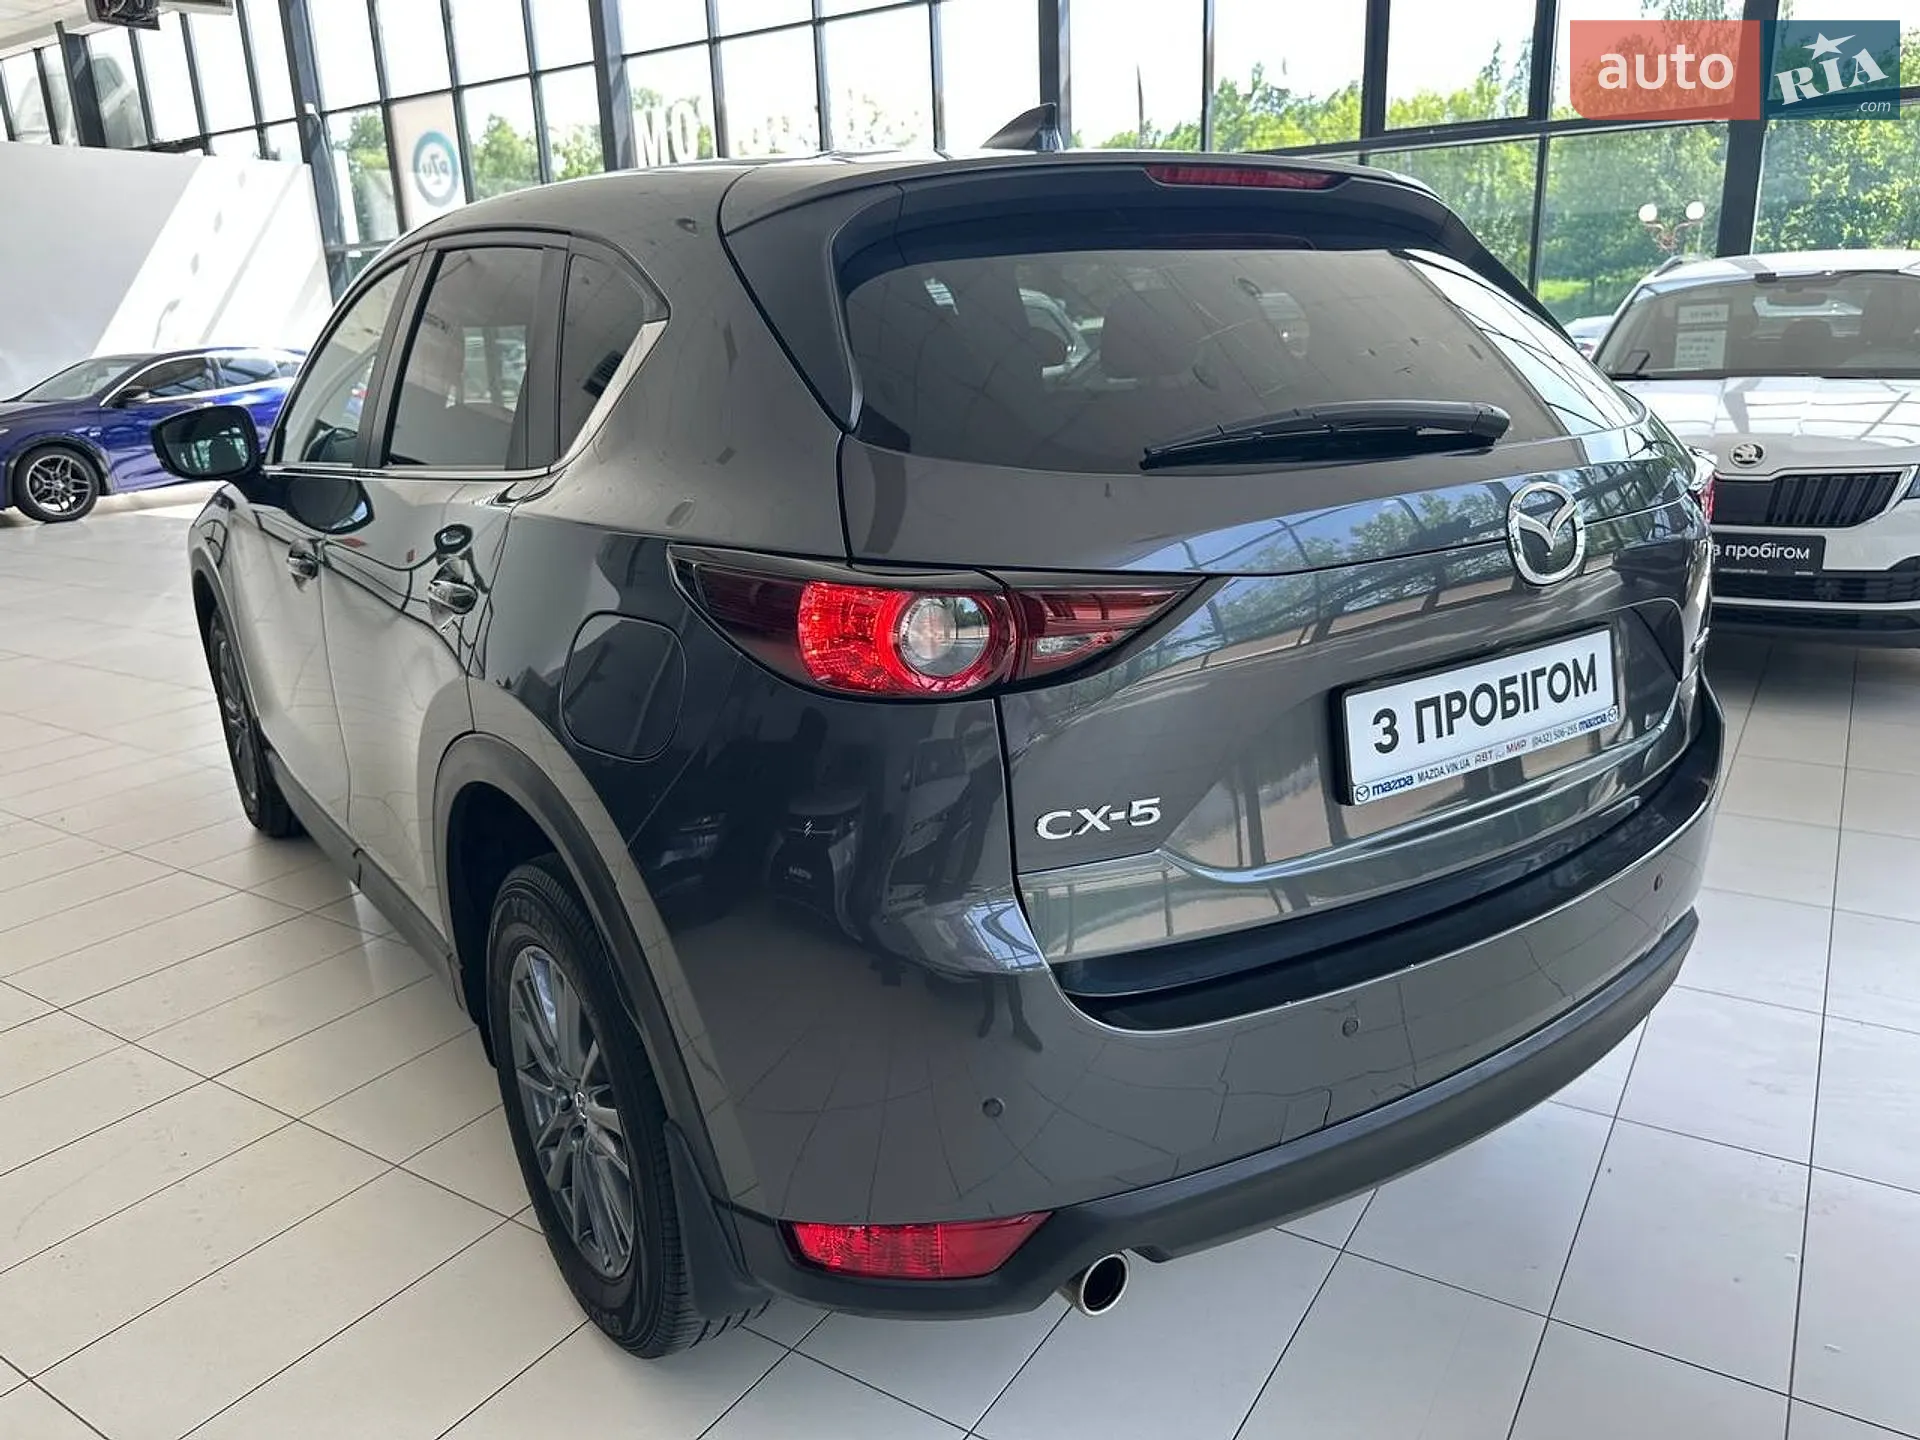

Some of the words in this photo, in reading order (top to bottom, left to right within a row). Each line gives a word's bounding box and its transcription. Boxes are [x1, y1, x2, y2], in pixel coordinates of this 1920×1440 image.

[1725, 542, 1810, 561] пробігом
[1372, 708, 1399, 754] З
[1415, 653, 1598, 744] ПРОБІГОМ
[1372, 775, 1414, 796] mazda
[1578, 713, 1607, 730] mazda
[1036, 796, 1160, 839] CX-5
